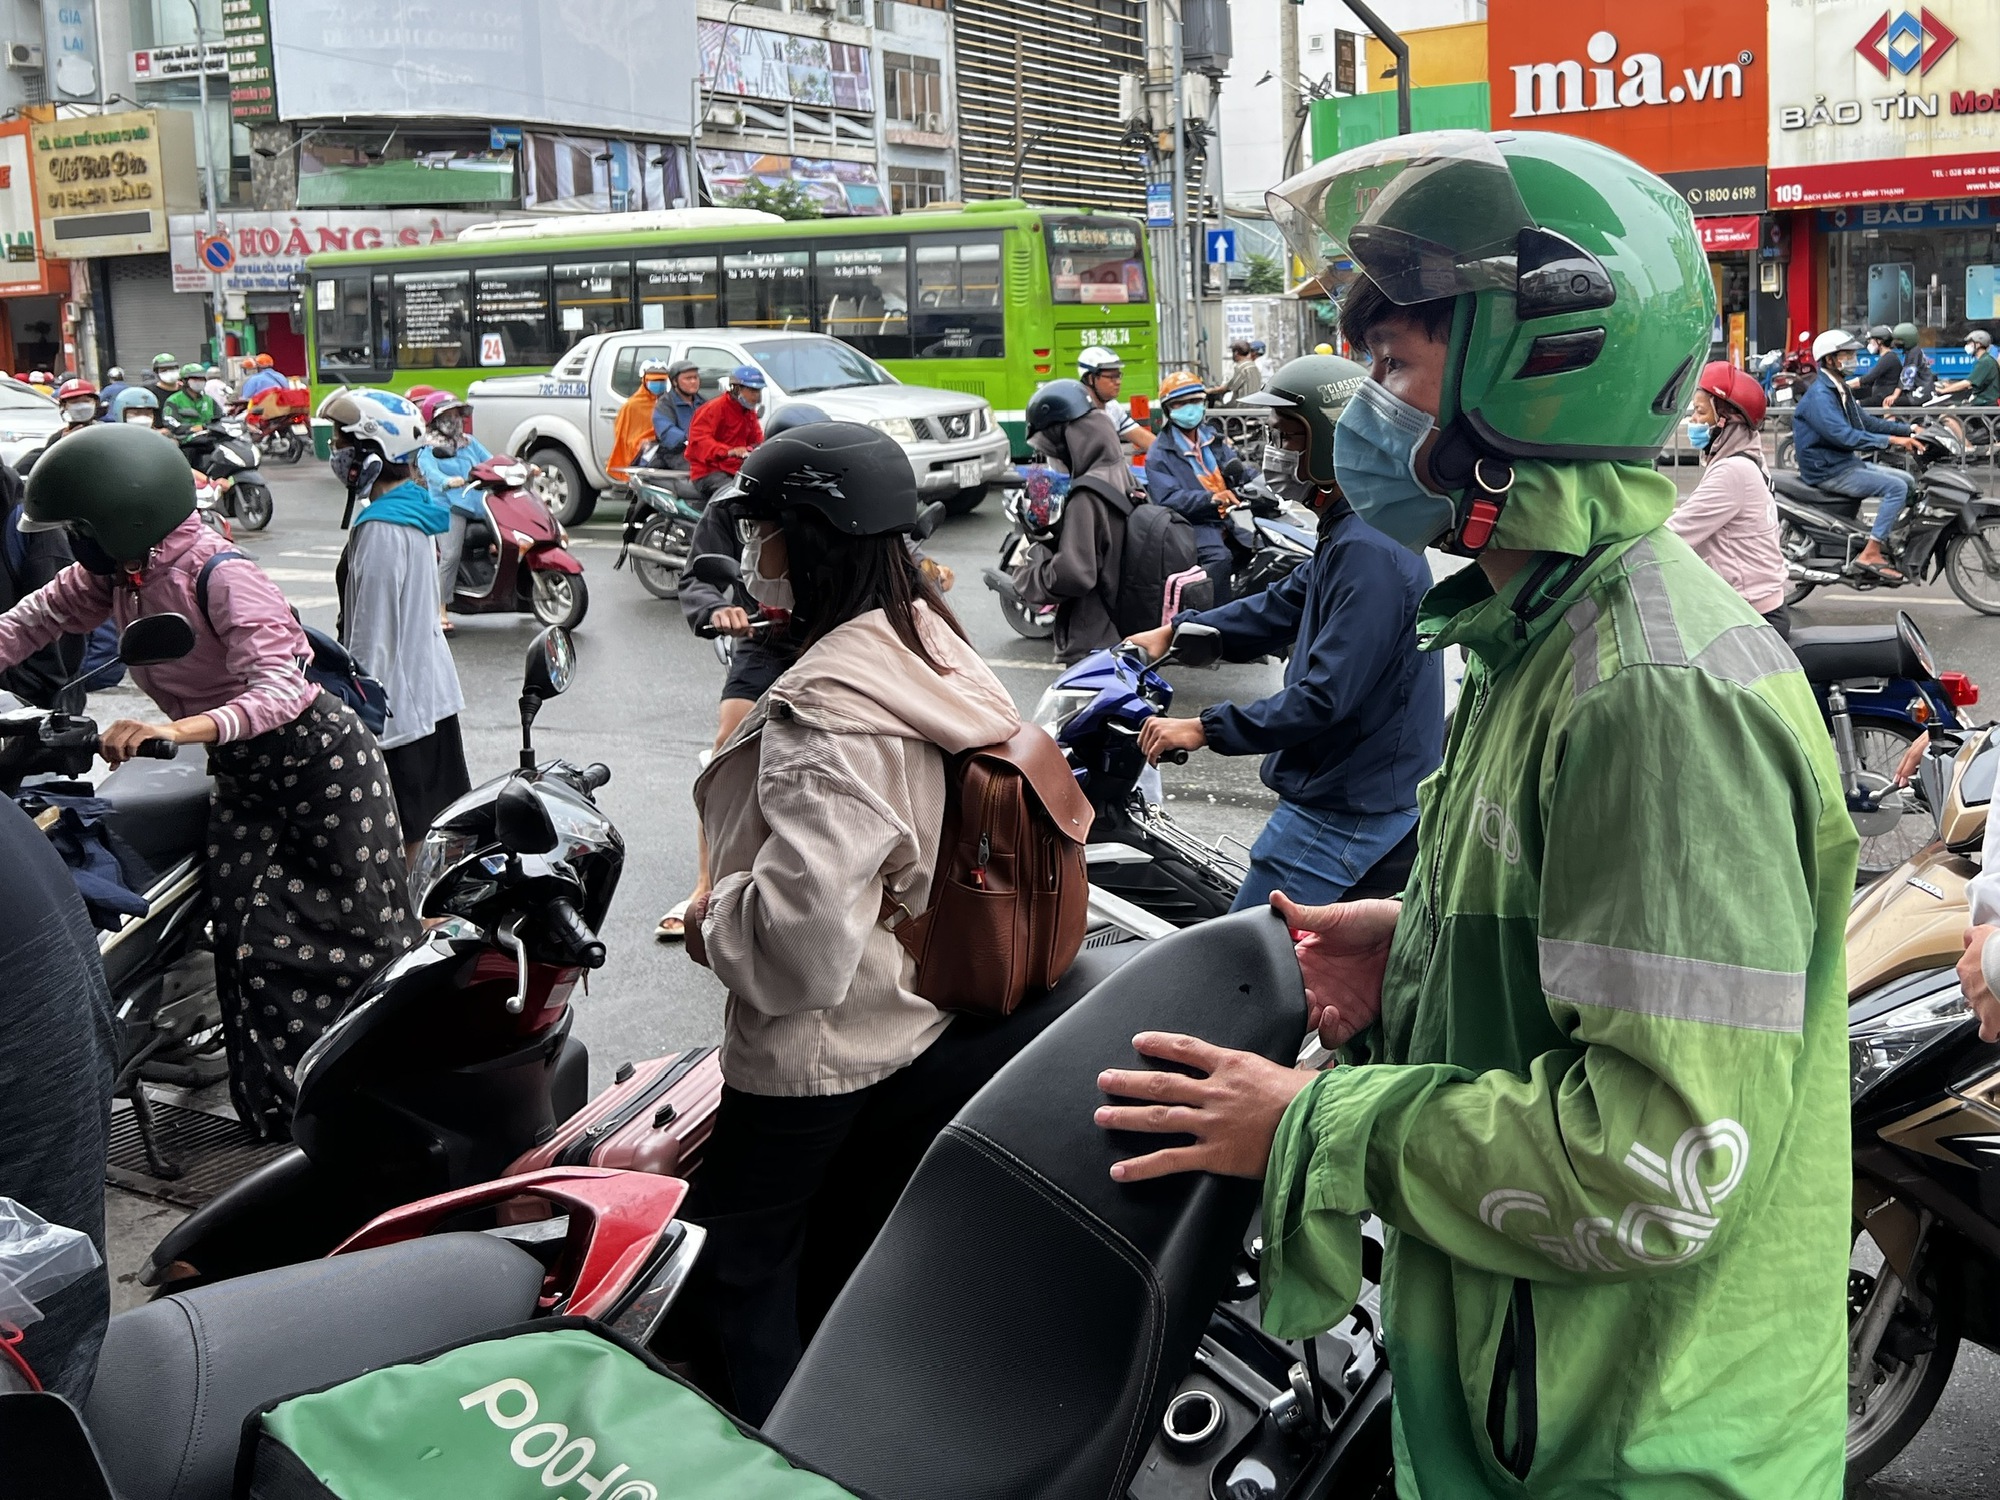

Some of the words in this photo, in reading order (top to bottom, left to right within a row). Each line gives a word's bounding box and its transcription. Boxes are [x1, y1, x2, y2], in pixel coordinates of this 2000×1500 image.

[58, 8, 82, 25] GIA
[63, 36, 84, 51] LAI
[1780, 95, 1861, 130] BẢO
[1872, 89, 1938, 121] TÍN
[1704, 189, 1730, 202] 1800
[1731, 186, 1757, 200] 6198
[1774, 184, 1802, 203] 109
[1880, 187, 1905, 198] THẠNH
[238, 217, 384, 256] HOÀNG
[1080, 328, 1130, 346] 51B-306.74
[484, 339, 501, 360] 24
[538, 383, 587, 396] 72C-021.50
